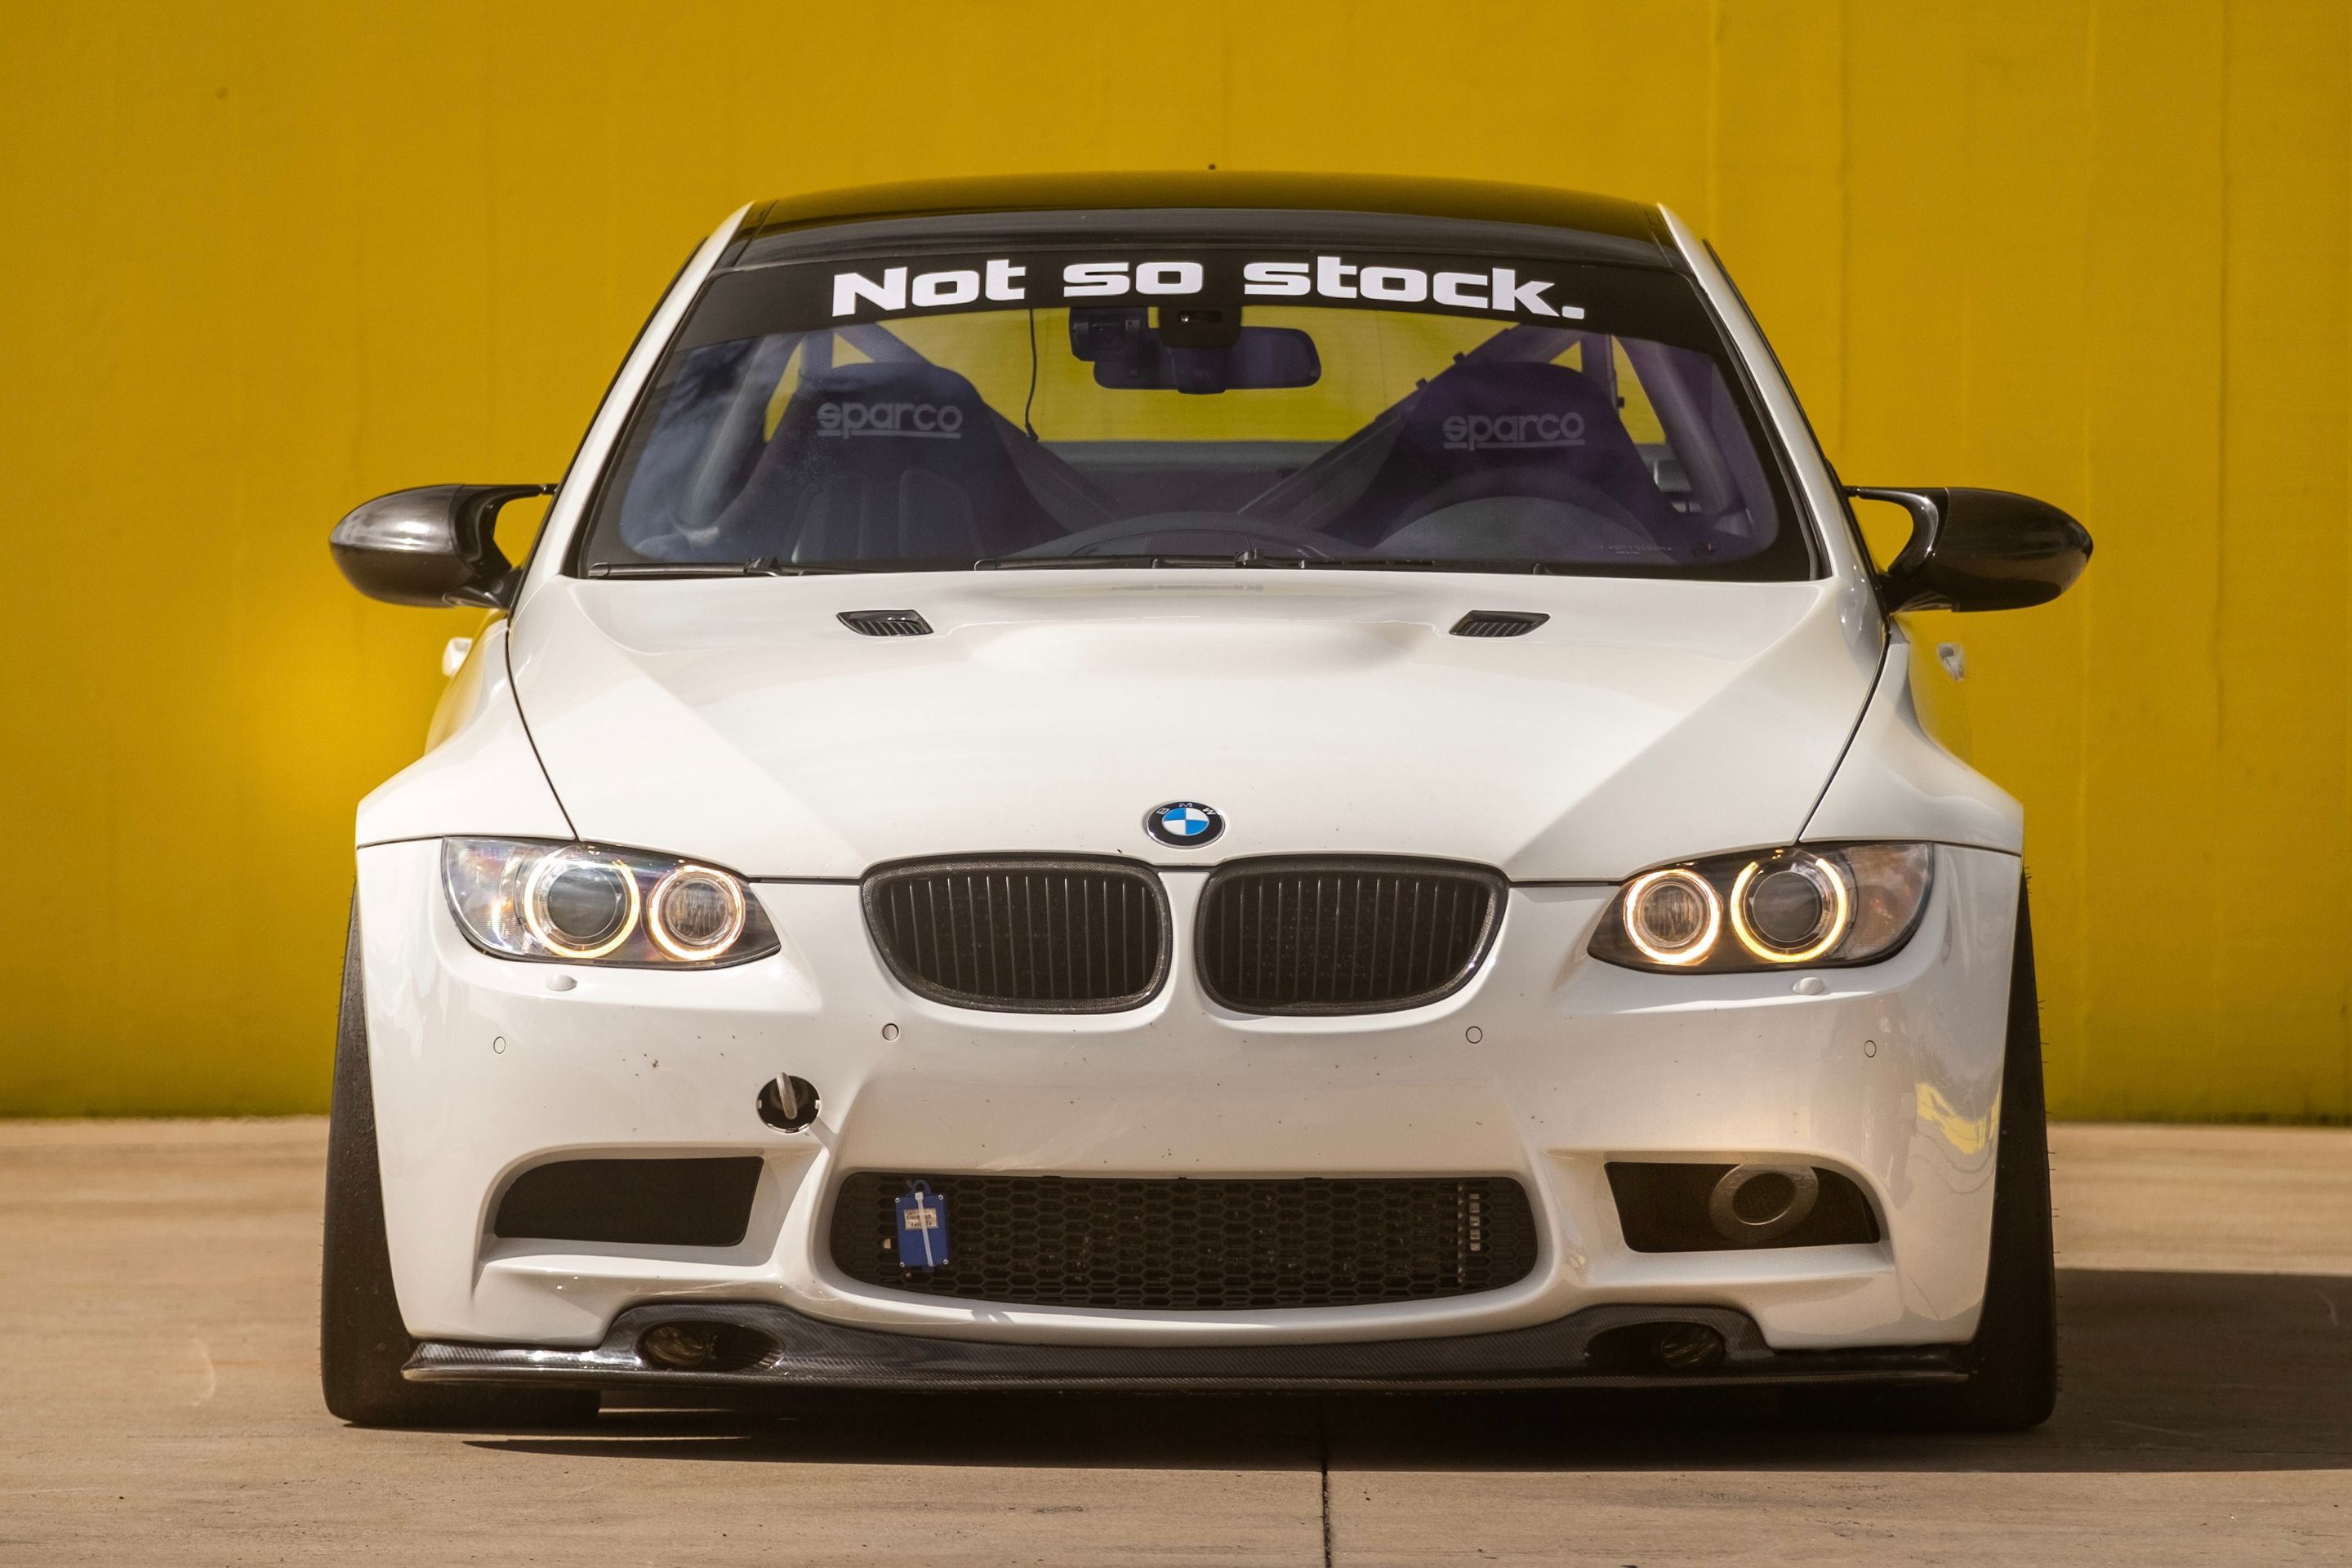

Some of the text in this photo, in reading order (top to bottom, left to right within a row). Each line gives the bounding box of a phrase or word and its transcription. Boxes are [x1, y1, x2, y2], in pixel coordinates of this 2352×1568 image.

[831, 256, 1585, 319] Not so stock.
[817, 402, 963, 439] sparco
[1442, 412, 1585, 451] sparco
[1156, 802, 1216, 815] BMW
